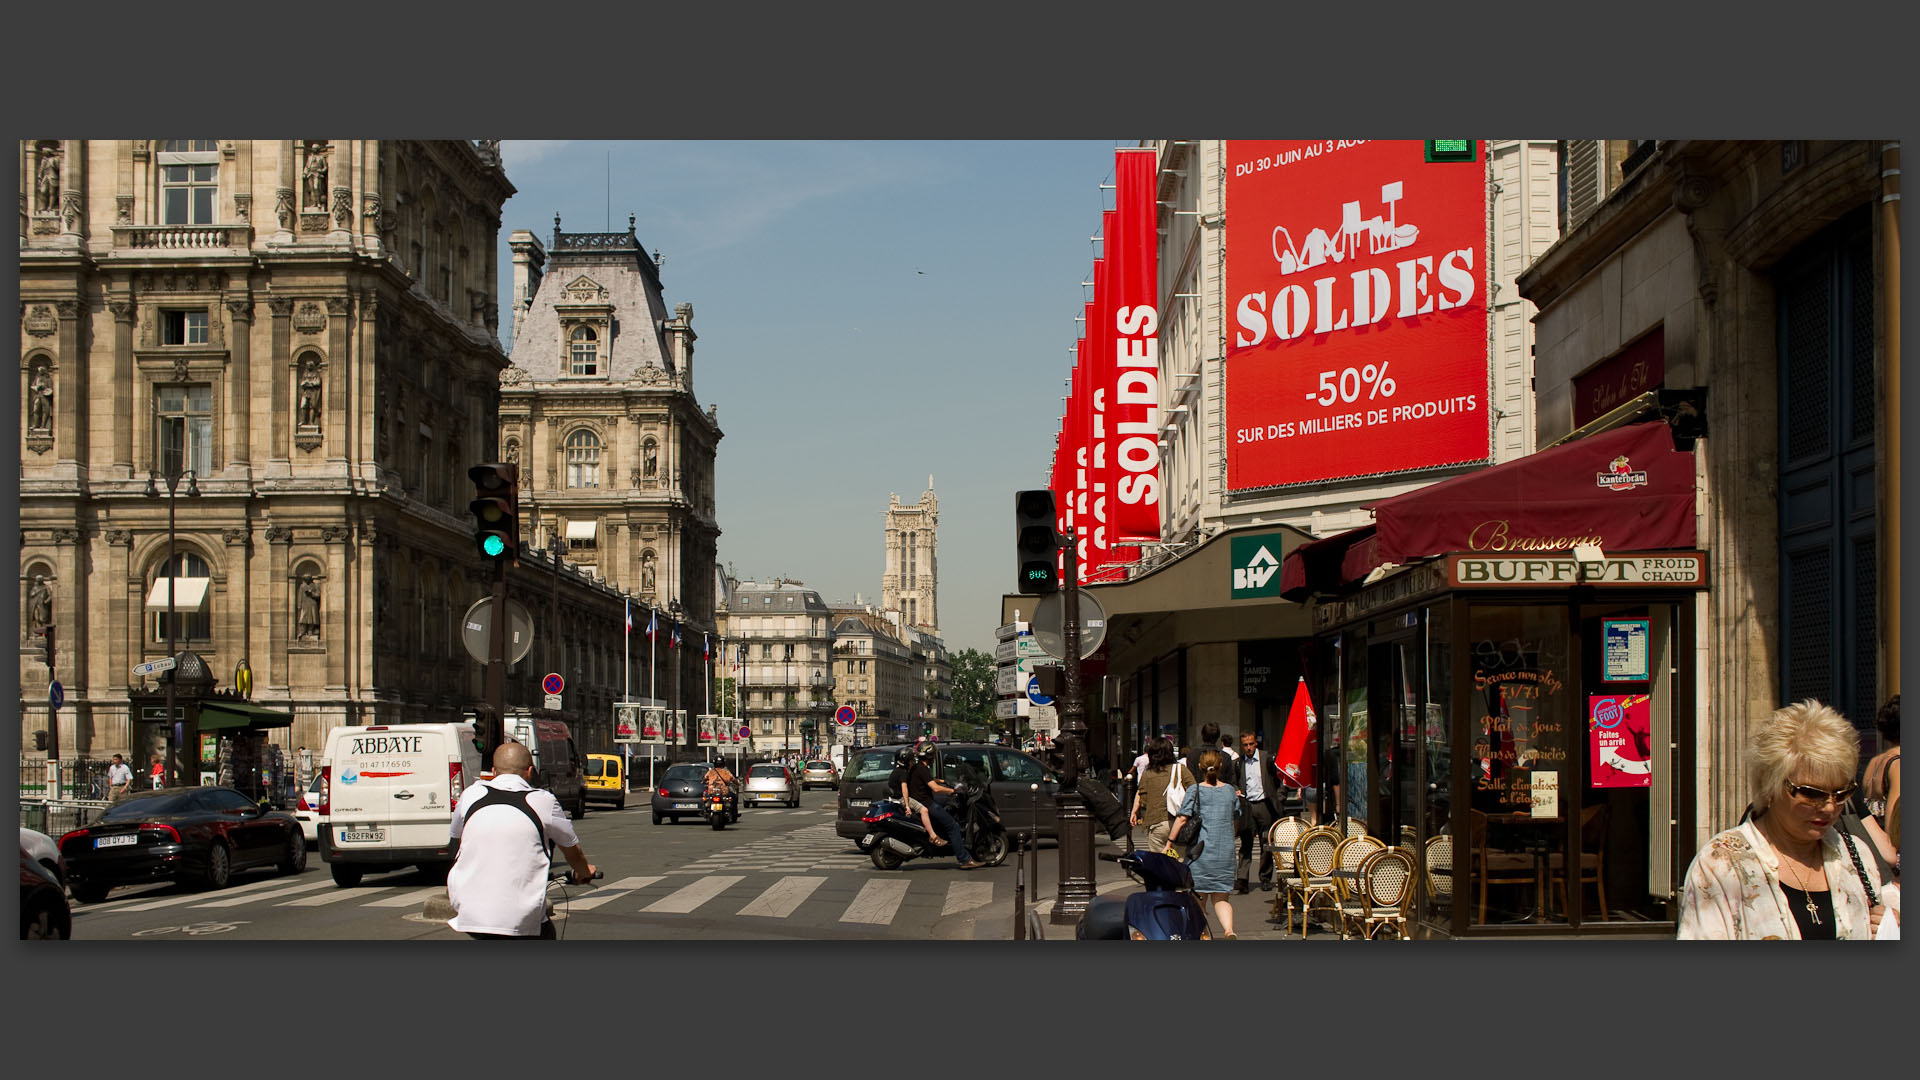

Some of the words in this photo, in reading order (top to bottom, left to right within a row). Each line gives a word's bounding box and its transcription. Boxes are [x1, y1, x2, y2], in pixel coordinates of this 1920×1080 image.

[1236, 161, 1254, 176] DU
[1256, 157, 1271, 171] 30
[1273, 148, 1302, 168] JUIN
[1304, 143, 1323, 159] AU
[1325, 140, 1334, 153] 3
[1236, 246, 1476, 349] SOLDES
[1305, 360, 1397, 407] -50%
[1116, 304, 1158, 505] SOLDES
[1236, 426, 1265, 444] SUR
[1267, 421, 1296, 440] DES
[1298, 412, 1364, 435] MILLIERS
[1366, 409, 1389, 427] DE
[1391, 395, 1477, 422] PRODUITS
[1599, 474, 1645, 485] Kanterbräu
[1468, 520, 1603, 551] Brasserie
[1461, 560, 1637, 581] BUFFET
[1642, 558, 1696, 569] FROID
[1029, 569, 1048, 580] BUS
[1233, 564, 1280, 590] BHV
[1641, 571, 1696, 581] CHAUD
[1243, 657, 1252, 666] Le
[1243, 666, 1271, 675] SAMEDI
[1474, 670, 1517, 691] Service
[1518, 671, 1537, 681] non
[1537, 669, 1564, 695] stop
[1599, 709, 1619, 723] FOOT
[1480, 715, 1512, 733] Plat
[1530, 715, 1562, 739] jour
[1598, 731, 1620, 739] Faites
[352, 736, 422, 754] ABBAYE
[1608, 738, 1626, 746] arrêt
[1474, 743, 1503, 760] Vins
[1477, 774, 1507, 791] Salle
[1511, 778, 1560, 791] climatisée
[347, 832, 360, 840] 692
[374, 832, 384, 840] 92
